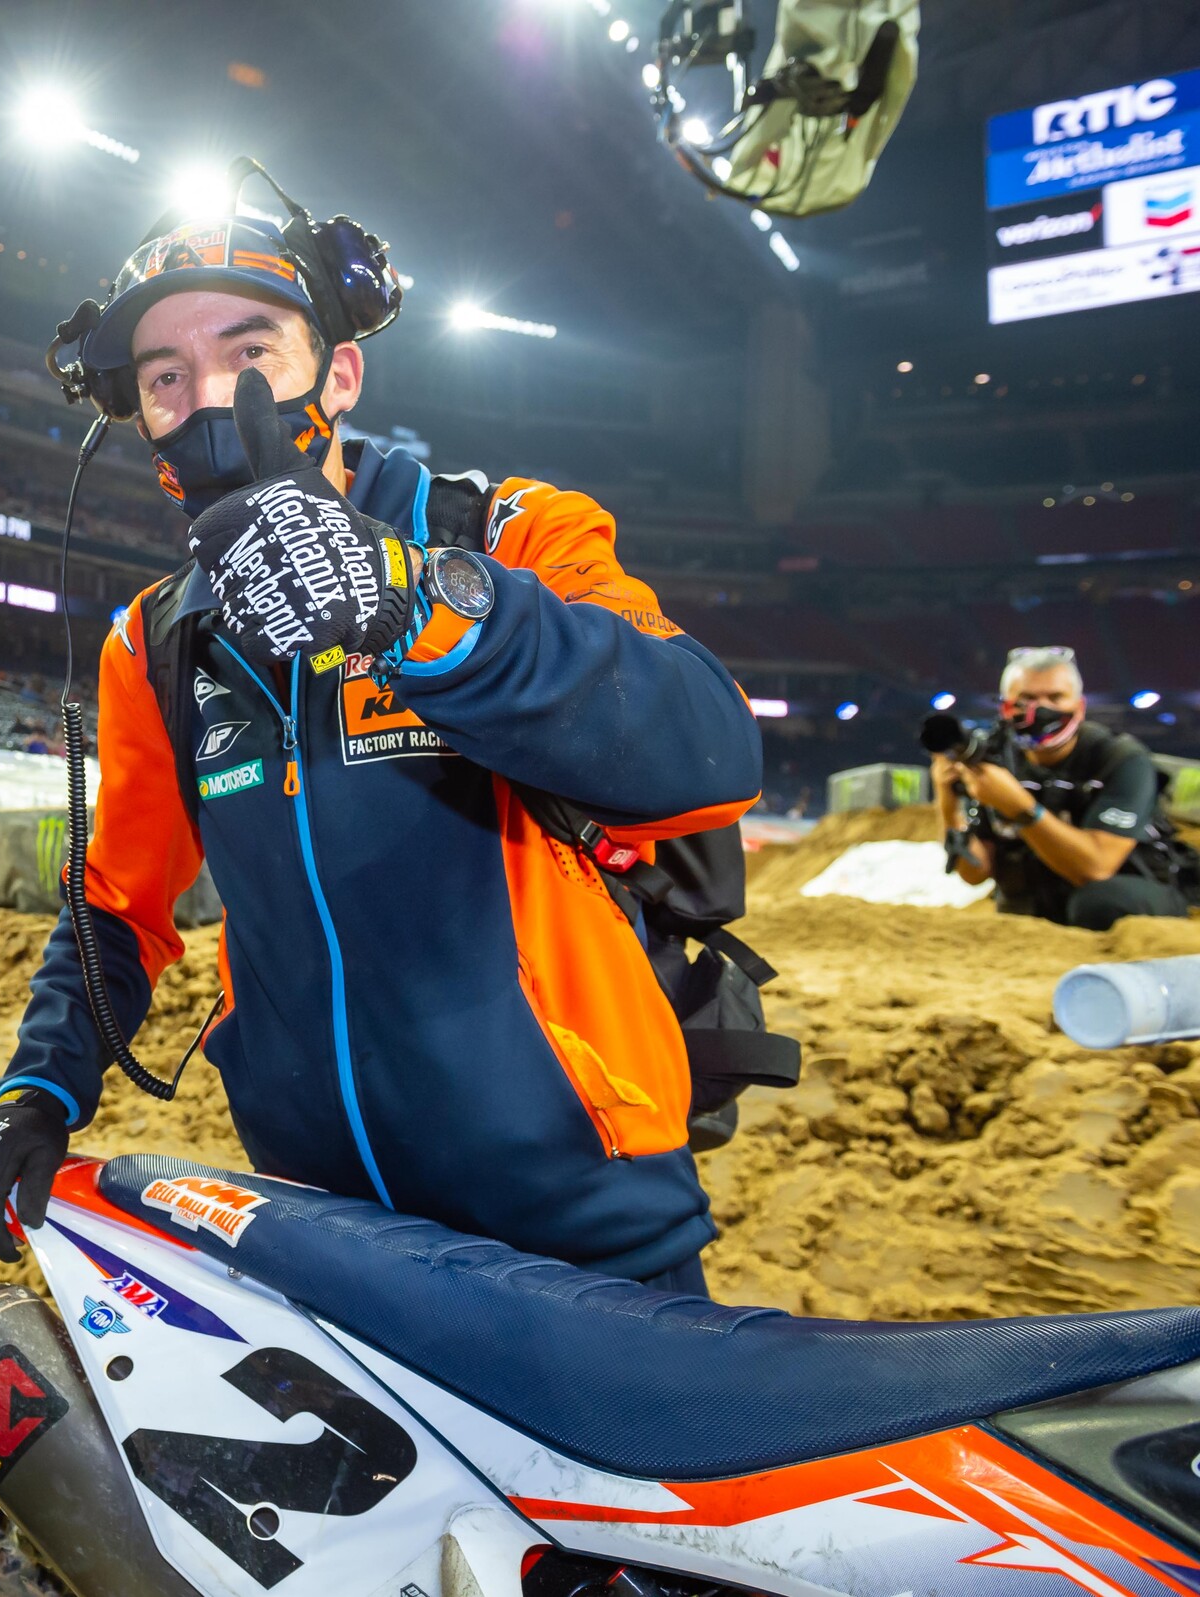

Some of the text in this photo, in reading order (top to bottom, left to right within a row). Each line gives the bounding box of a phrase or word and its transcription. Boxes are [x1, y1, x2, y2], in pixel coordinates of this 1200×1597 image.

[1033, 79, 1176, 144] RTIC
[254, 479, 347, 611] Mechanix
[224, 523, 314, 651] Mechanix
[345, 653, 376, 678] Re
[349, 732, 404, 756] FACTORY
[208, 763, 260, 795] MOTOREX
[145, 1181, 246, 1237] SELLE DALLA VALLE
[170, 1177, 260, 1211] KTM
[177, 1208, 198, 1222] ITALY
[102, 1275, 166, 1317] AMA
[90, 1310, 111, 1328] FIM
[121, 1346, 418, 1590] 2
